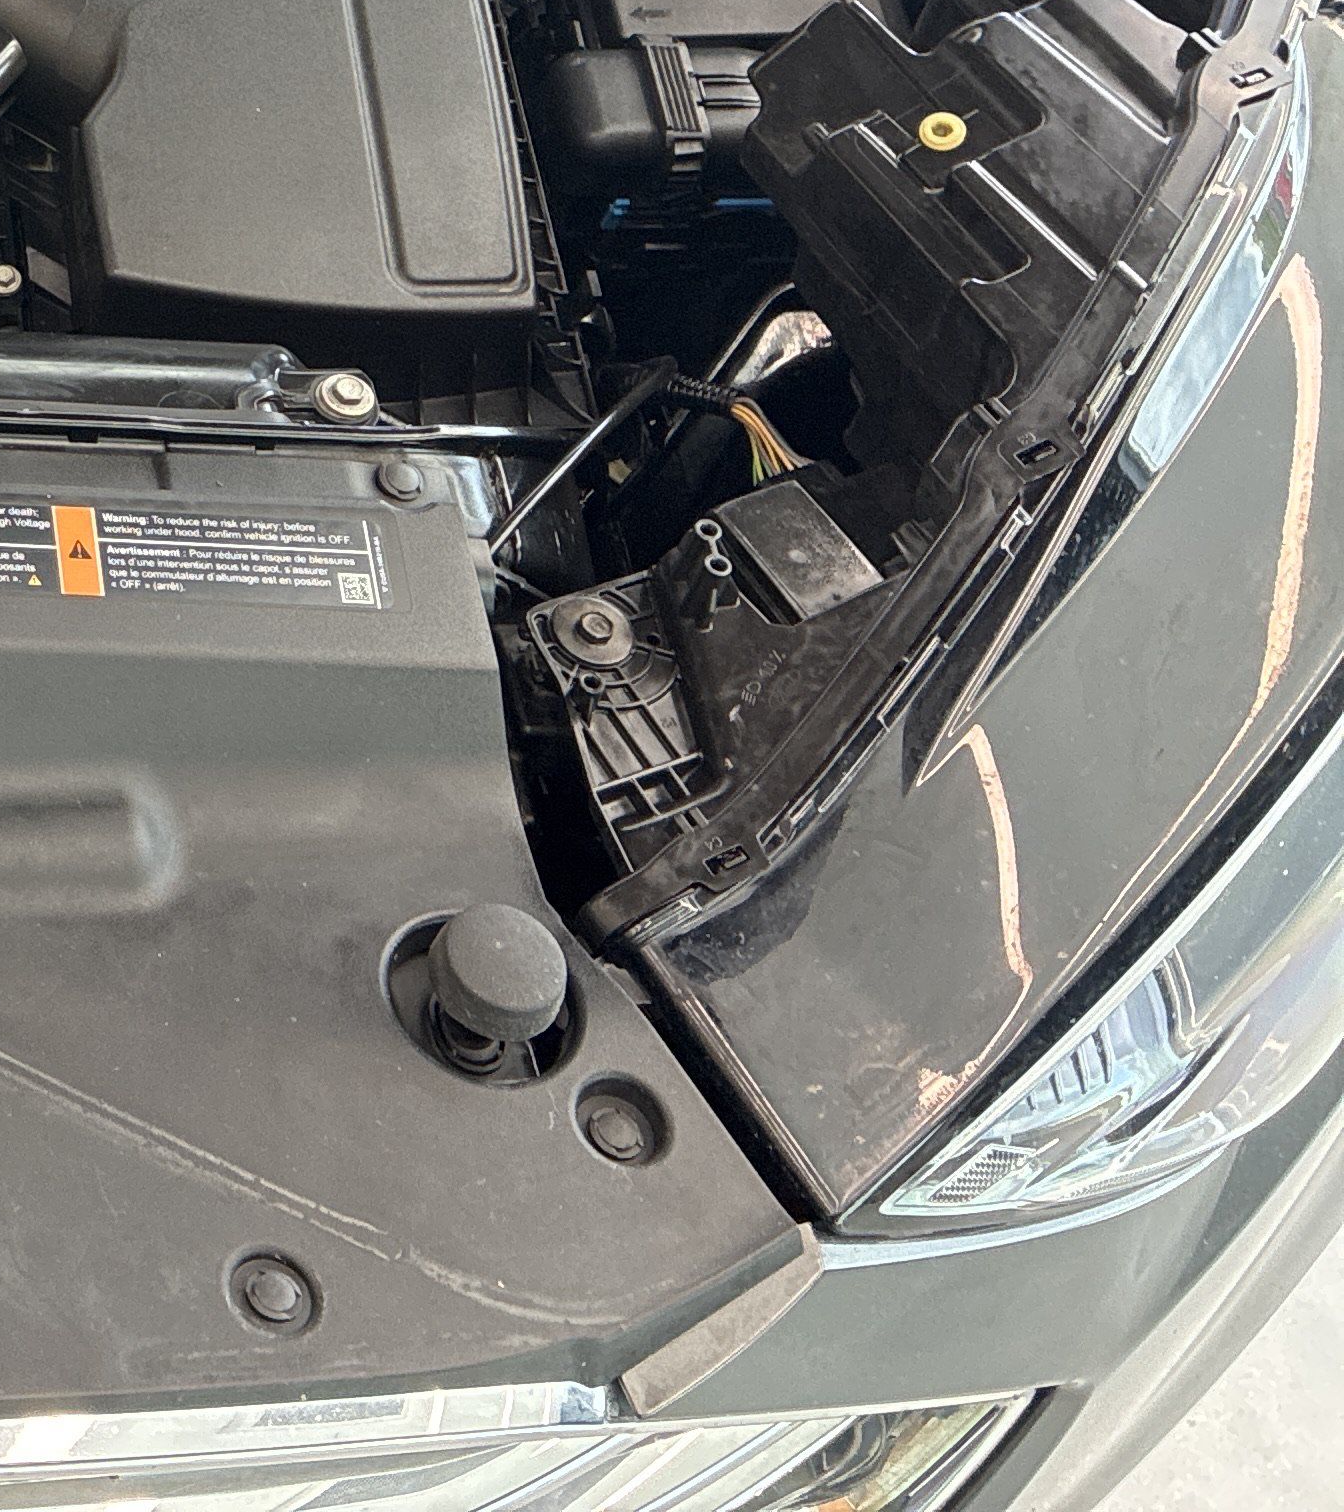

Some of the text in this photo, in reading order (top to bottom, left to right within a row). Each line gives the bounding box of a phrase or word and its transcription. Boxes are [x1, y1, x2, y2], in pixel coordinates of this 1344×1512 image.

[13, 518, 50, 531] Voltage
[102, 513, 150, 526] Warning:
[152, 515, 164, 524] To
[166, 516, 200, 526] reduce
[202, 518, 218, 527] the
[221, 519, 237, 528] risk
[240, 520, 249, 529] of
[283, 522, 315, 532] before
[104, 524, 142, 537] working
[145, 526, 172, 536] under
[205, 530, 241, 539] confirm
[243, 531, 278, 541] vehicle
[280, 533, 316, 544] ignition
[318, 535, 326, 544] is
[328, 535, 353, 545] OFF.
[13, 551, 25, 561] de
[107, 546, 179, 558] Avertissement
[189, 550, 212, 559] Pour
[214, 551, 248, 561] réduire
[250, 553, 260, 562] le
[262, 553, 291, 565] risque
[294, 555, 306, 564] de
[308, 555, 355, 566] blessures
[108, 557, 125, 566] lors
[128, 558, 155, 568] d'une
[157, 559, 213, 571] intervention
[241, 564, 250, 573] le
[284, 566, 328, 577] s'assurer
[109, 569, 127, 578] que
[130, 568, 139, 577] le
[142, 570, 204, 580] commutateur
[207, 572, 259, 586] d'allumage
[261, 575, 277, 584] est
[294, 577, 331, 588] position
[120, 579, 141, 588] OFF
